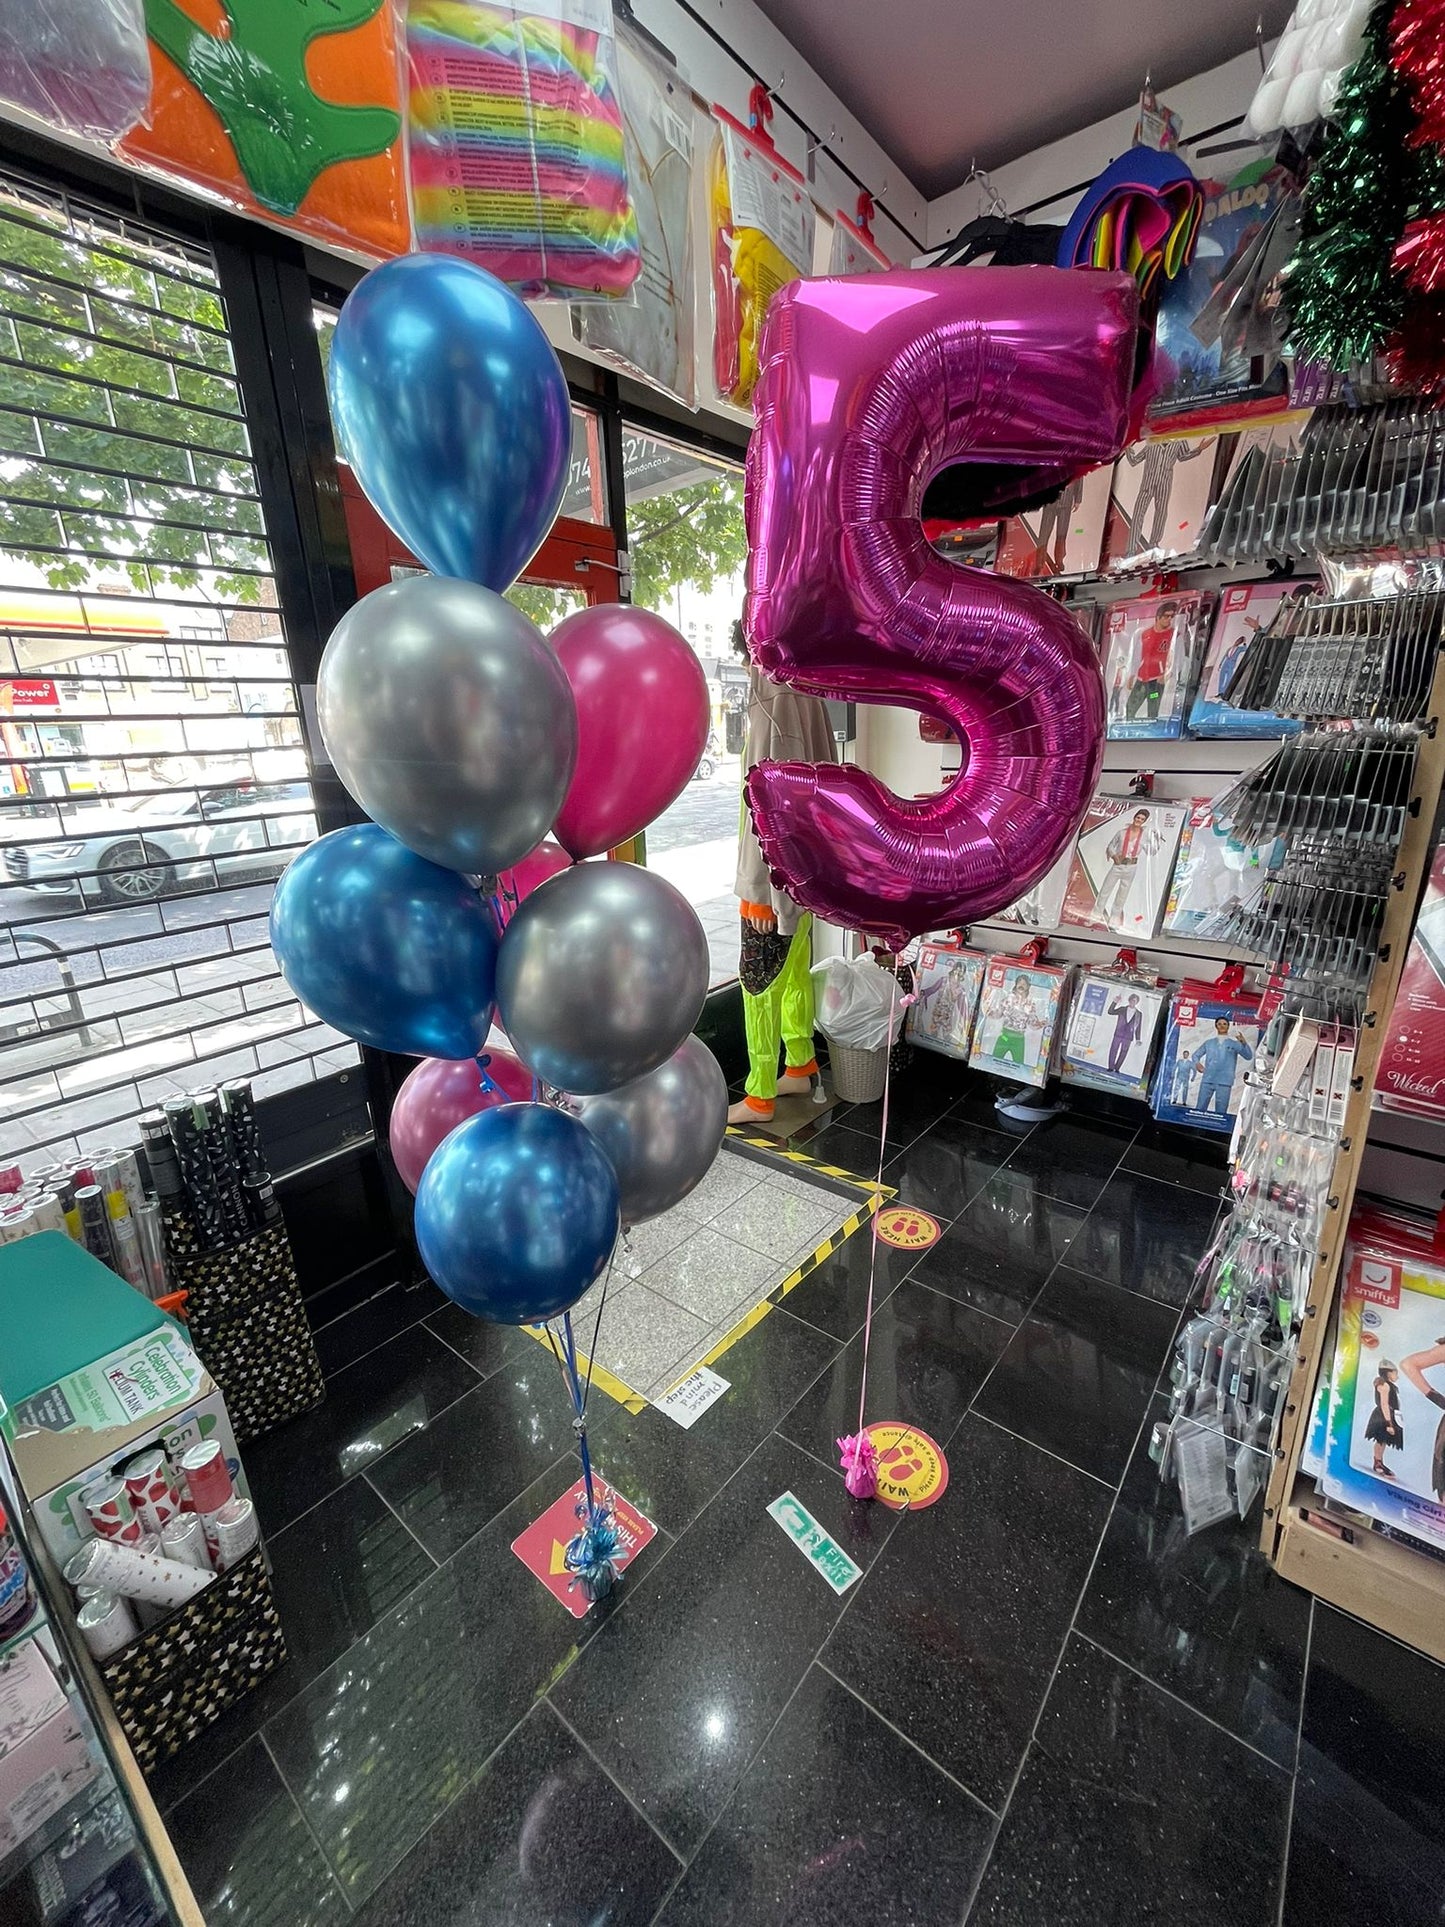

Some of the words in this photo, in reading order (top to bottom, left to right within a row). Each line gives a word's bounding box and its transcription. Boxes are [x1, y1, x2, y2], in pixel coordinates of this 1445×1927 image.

[1387, 1070, 1444, 1095] Wicked
[880, 1226, 901, 1242] HERE
[904, 1234, 928, 1245] WAIT
[1354, 1286, 1397, 1305] smiffys
[126, 1360, 161, 1401] Cylinders
[145, 1346, 182, 1395] Celebration
[684, 1371, 704, 1387] the
[125, 1392, 144, 1415] TANK
[665, 1387, 686, 1405] step
[679, 1382, 706, 1407] mind
[914, 1438, 927, 1451] safe
[928, 1457, 937, 1473] keep
[919, 1475, 936, 1493] Please
[1386, 1488, 1421, 1509] Viking
[617, 1524, 638, 1549] THIS
[818, 1556, 843, 1584] exit
[825, 1547, 853, 1576] Fire
